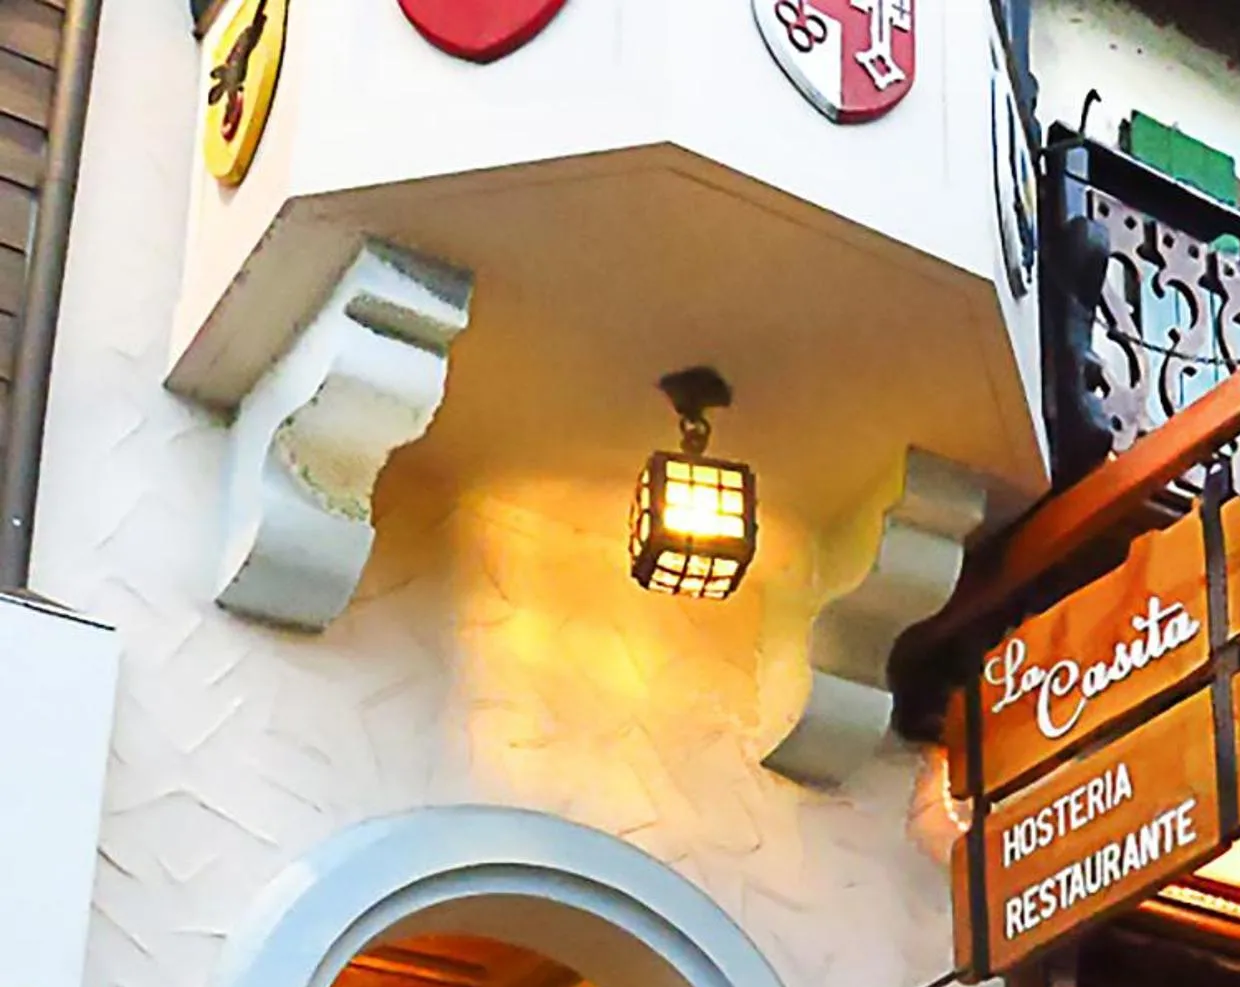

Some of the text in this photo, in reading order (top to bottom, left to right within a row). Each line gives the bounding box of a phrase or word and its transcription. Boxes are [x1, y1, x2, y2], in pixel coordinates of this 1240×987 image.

[984, 596, 1200, 738] La Casita
[1002, 762, 1133, 868] HOSTERIA
[1005, 799, 1198, 939] RESTAURANTE
